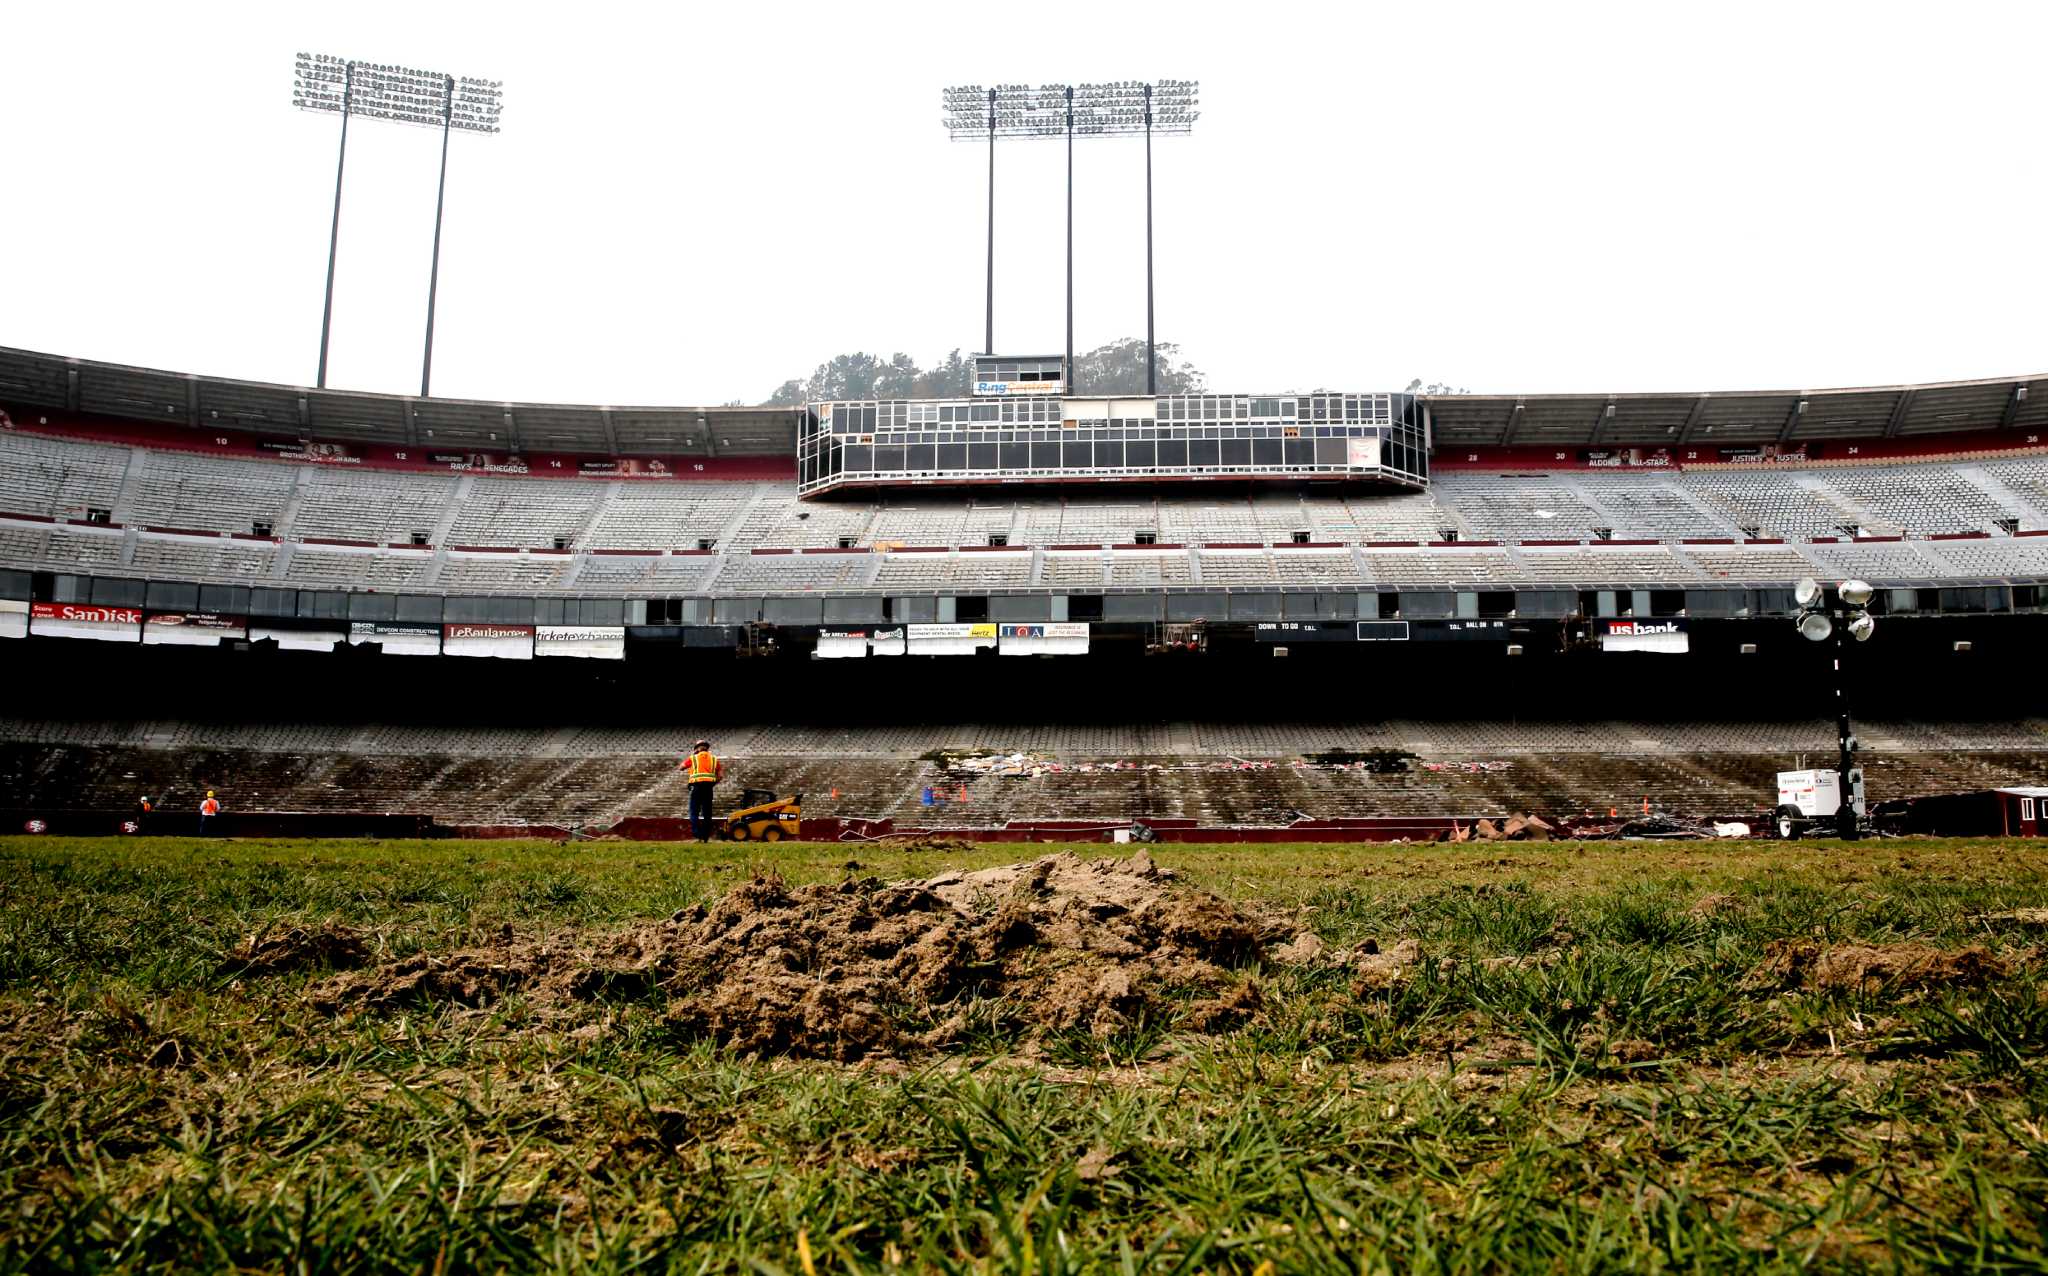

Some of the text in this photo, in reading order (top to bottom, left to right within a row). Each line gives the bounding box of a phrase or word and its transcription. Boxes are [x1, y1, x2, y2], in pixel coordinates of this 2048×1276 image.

[978, 382, 1053, 393] RingCentral
[215, 437, 228, 446] 10
[2027, 435, 2040, 444] 36
[1847, 446, 1858, 454] 34
[396, 452, 407, 460] 12
[1555, 452, 1566, 461] 30
[1731, 453, 1806, 463] JUSTIN'S JUSTICE
[550, 460, 562, 468] 14
[694, 463, 704, 471] 16
[1630, 458, 1669, 467] ALL-STARS
[450, 462, 529, 474] RAY'S RENEGADES
[62, 606, 142, 624] SanDisk
